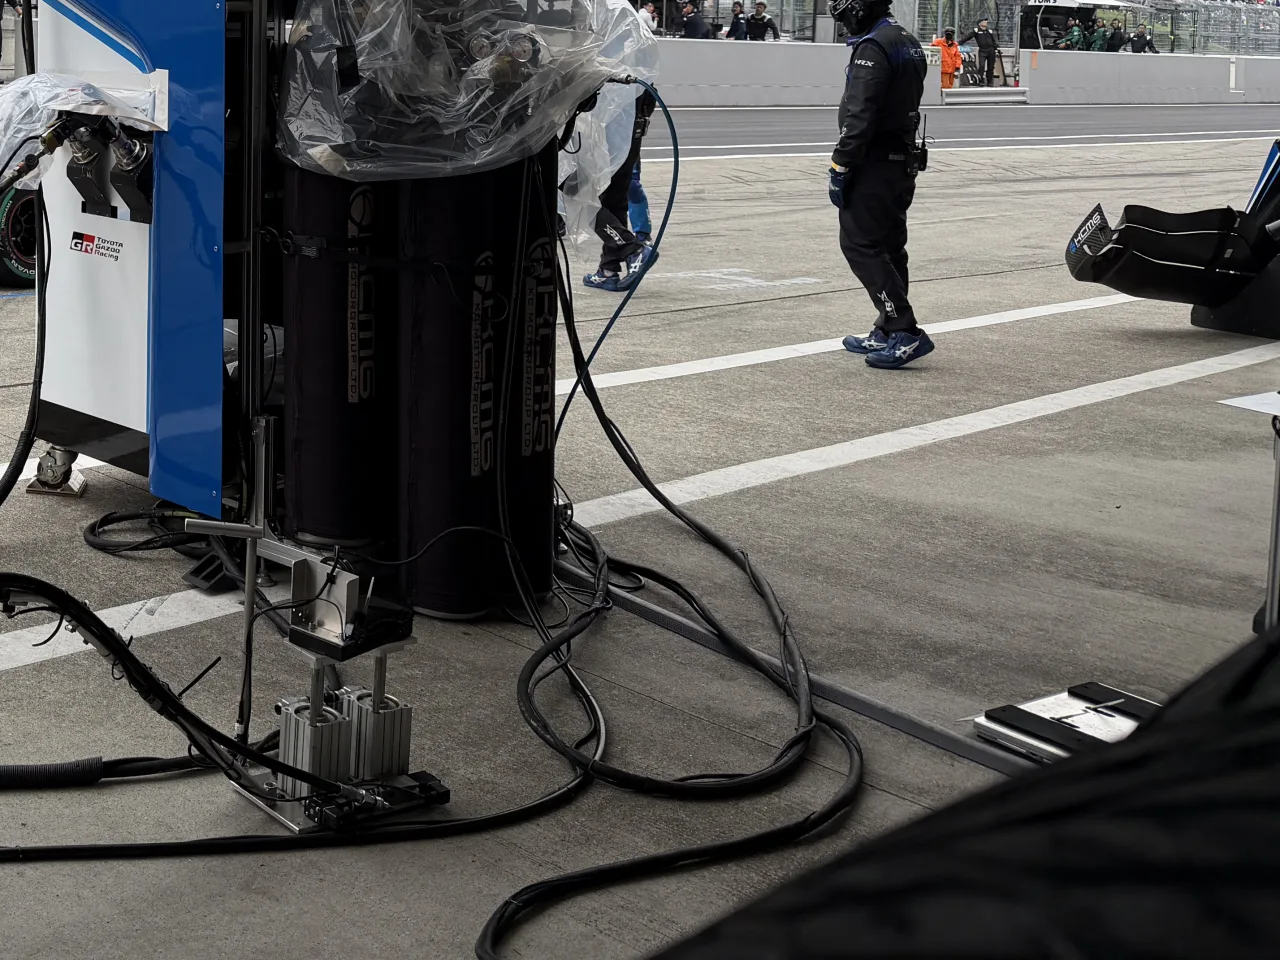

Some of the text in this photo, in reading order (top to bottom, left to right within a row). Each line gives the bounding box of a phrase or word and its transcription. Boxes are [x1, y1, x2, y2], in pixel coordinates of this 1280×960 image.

[1073, 211, 1101, 248] KCMG
[95, 243, 121, 254] GAZOO
[96, 236, 124, 248] TOYOTA
[94, 249, 119, 262] Racing
[11, 259, 36, 275] DVAN
